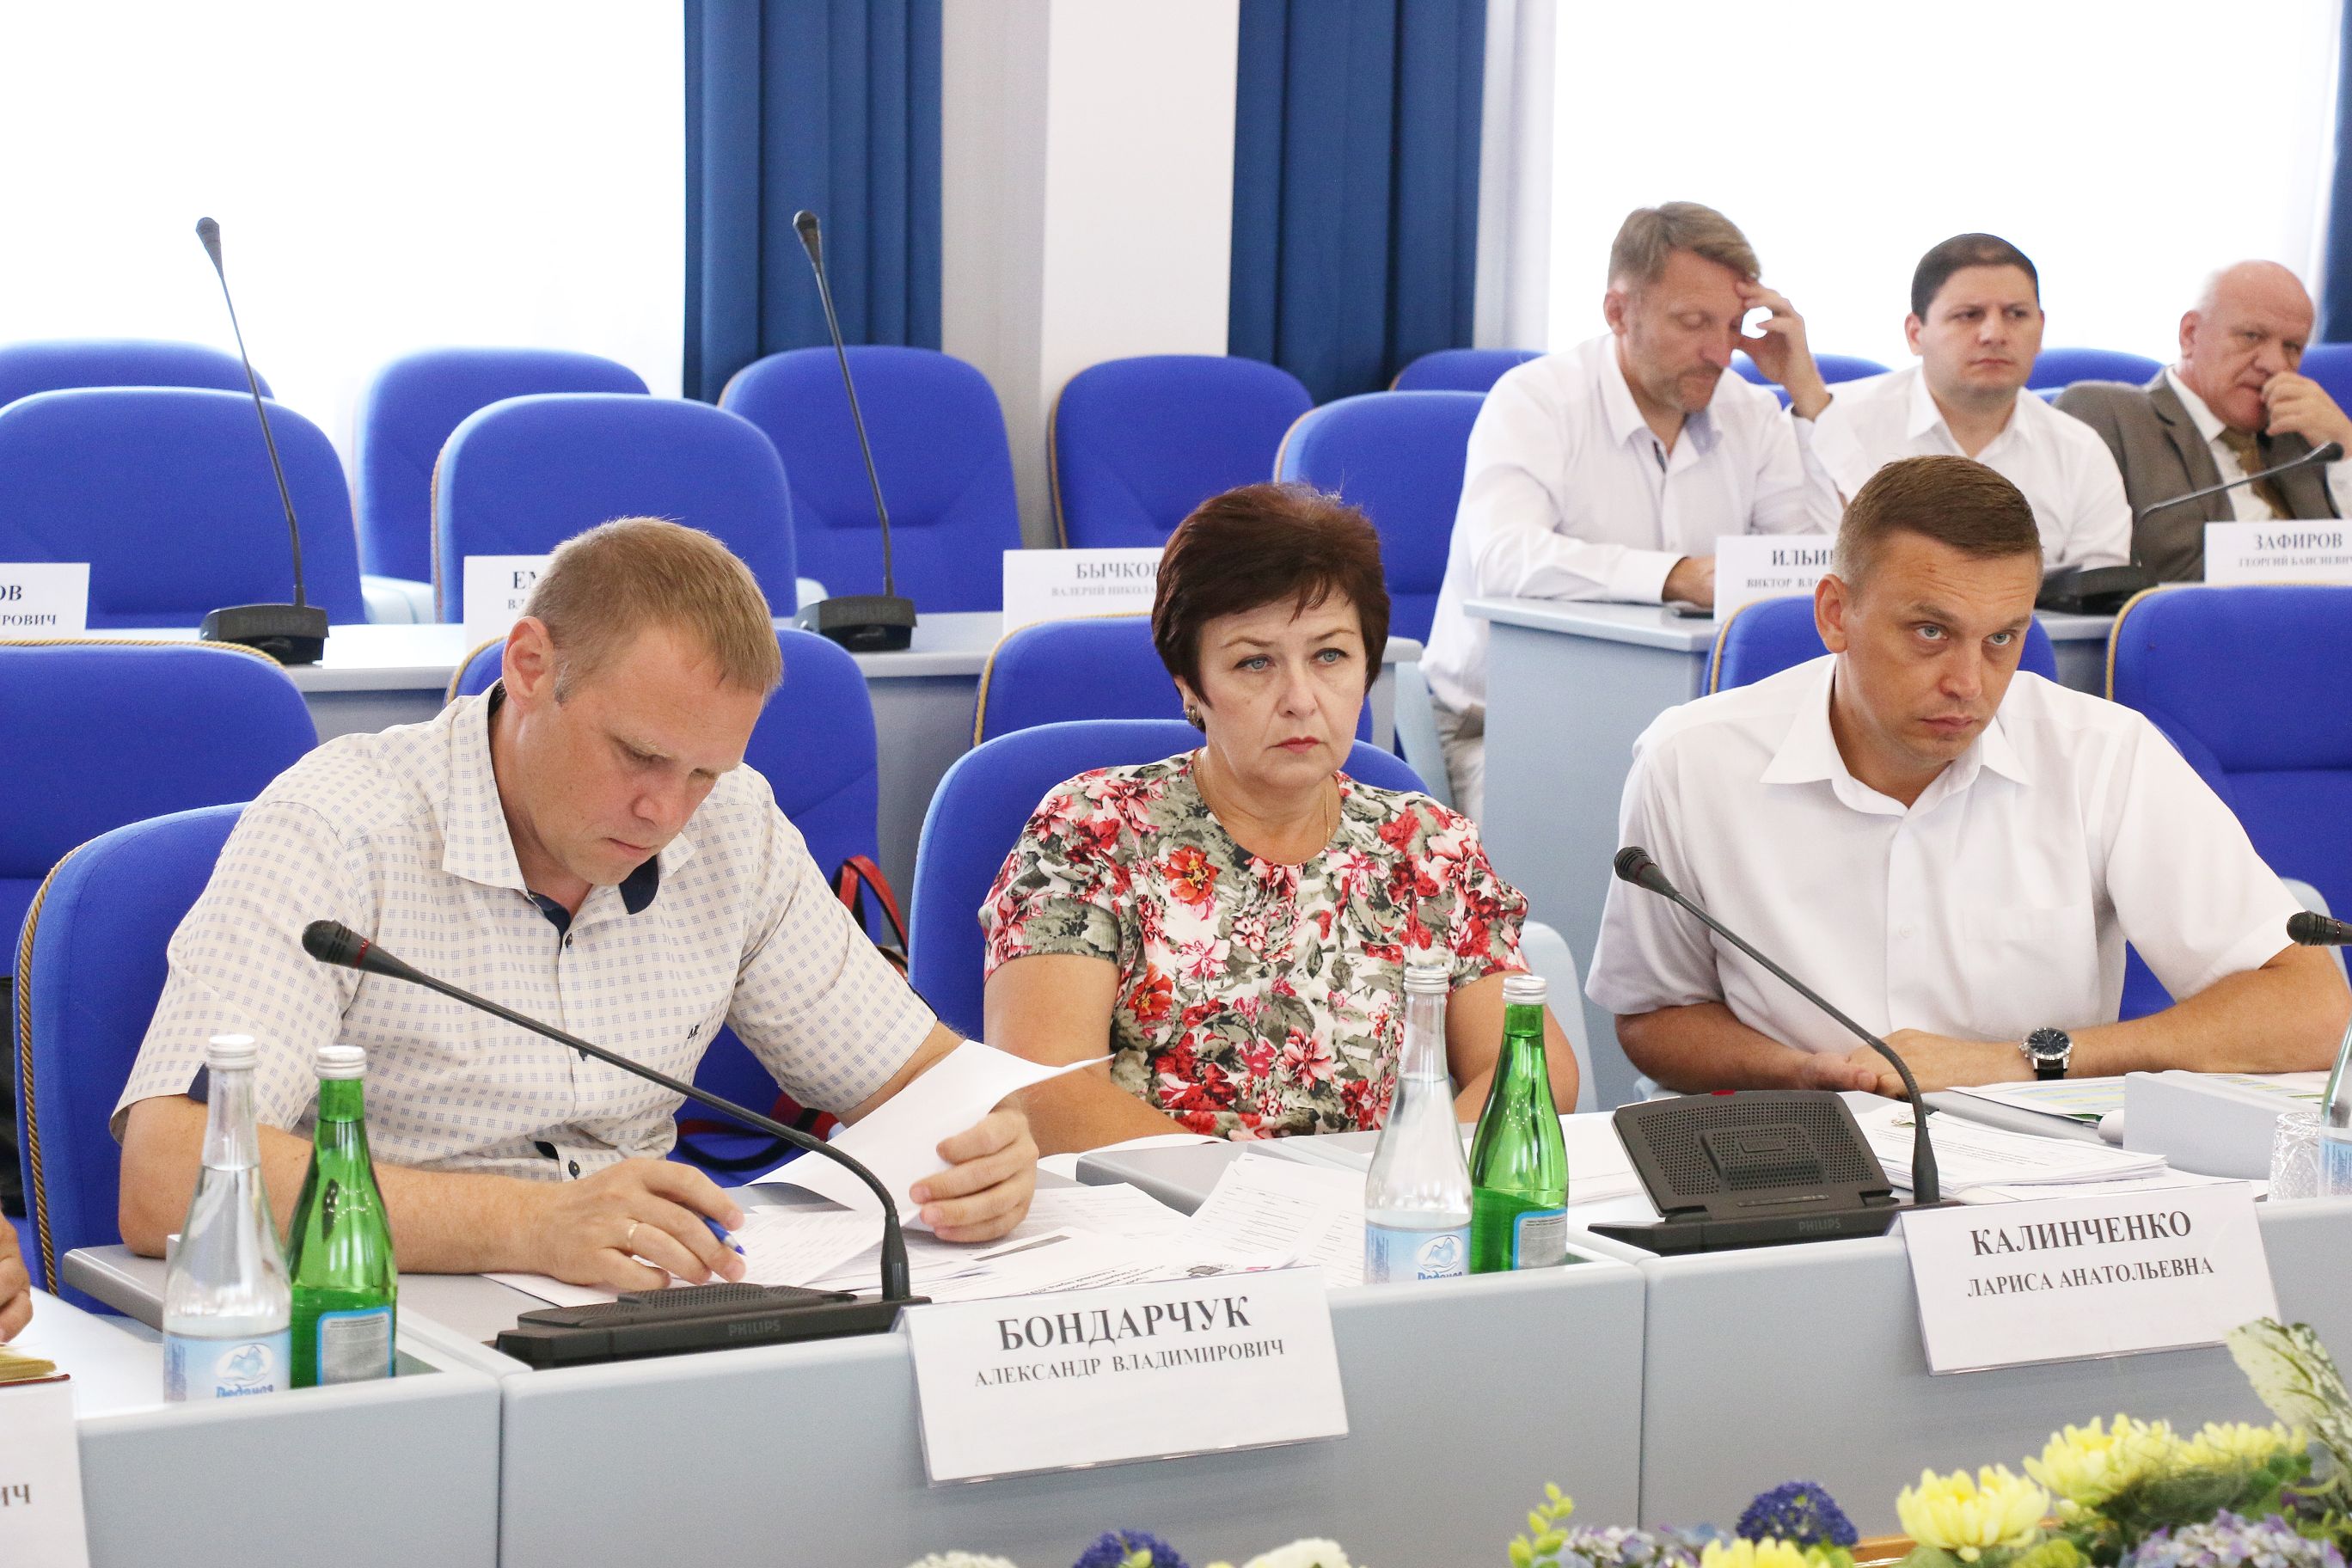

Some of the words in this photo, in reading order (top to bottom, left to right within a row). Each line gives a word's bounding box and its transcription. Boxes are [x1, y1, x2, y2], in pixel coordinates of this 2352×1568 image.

[2255, 532, 2343, 551] ЗАФИРОВ
[1773, 549, 1834, 566] ИЛЬИ
[1051, 585, 1106, 597] ВАЛЕРИЙ
[1747, 578, 1792, 588] ВИКТОР
[1798, 1217, 1841, 1232] PHILIPS
[1969, 1210, 2191, 1256] КАЛИНЧЕНКО
[1968, 1272, 2054, 1297] ЛАРИСА
[2060, 1256, 2214, 1288] АНАТОЛЬЕВНА
[728, 1320, 781, 1336] PHILIPS
[997, 1295, 1252, 1351] БОНДАРЧУК
[975, 1358, 1101, 1387] АЛЕКСАНДР
[1113, 1339, 1285, 1373] ВЛАДИМИРОВИЧ
